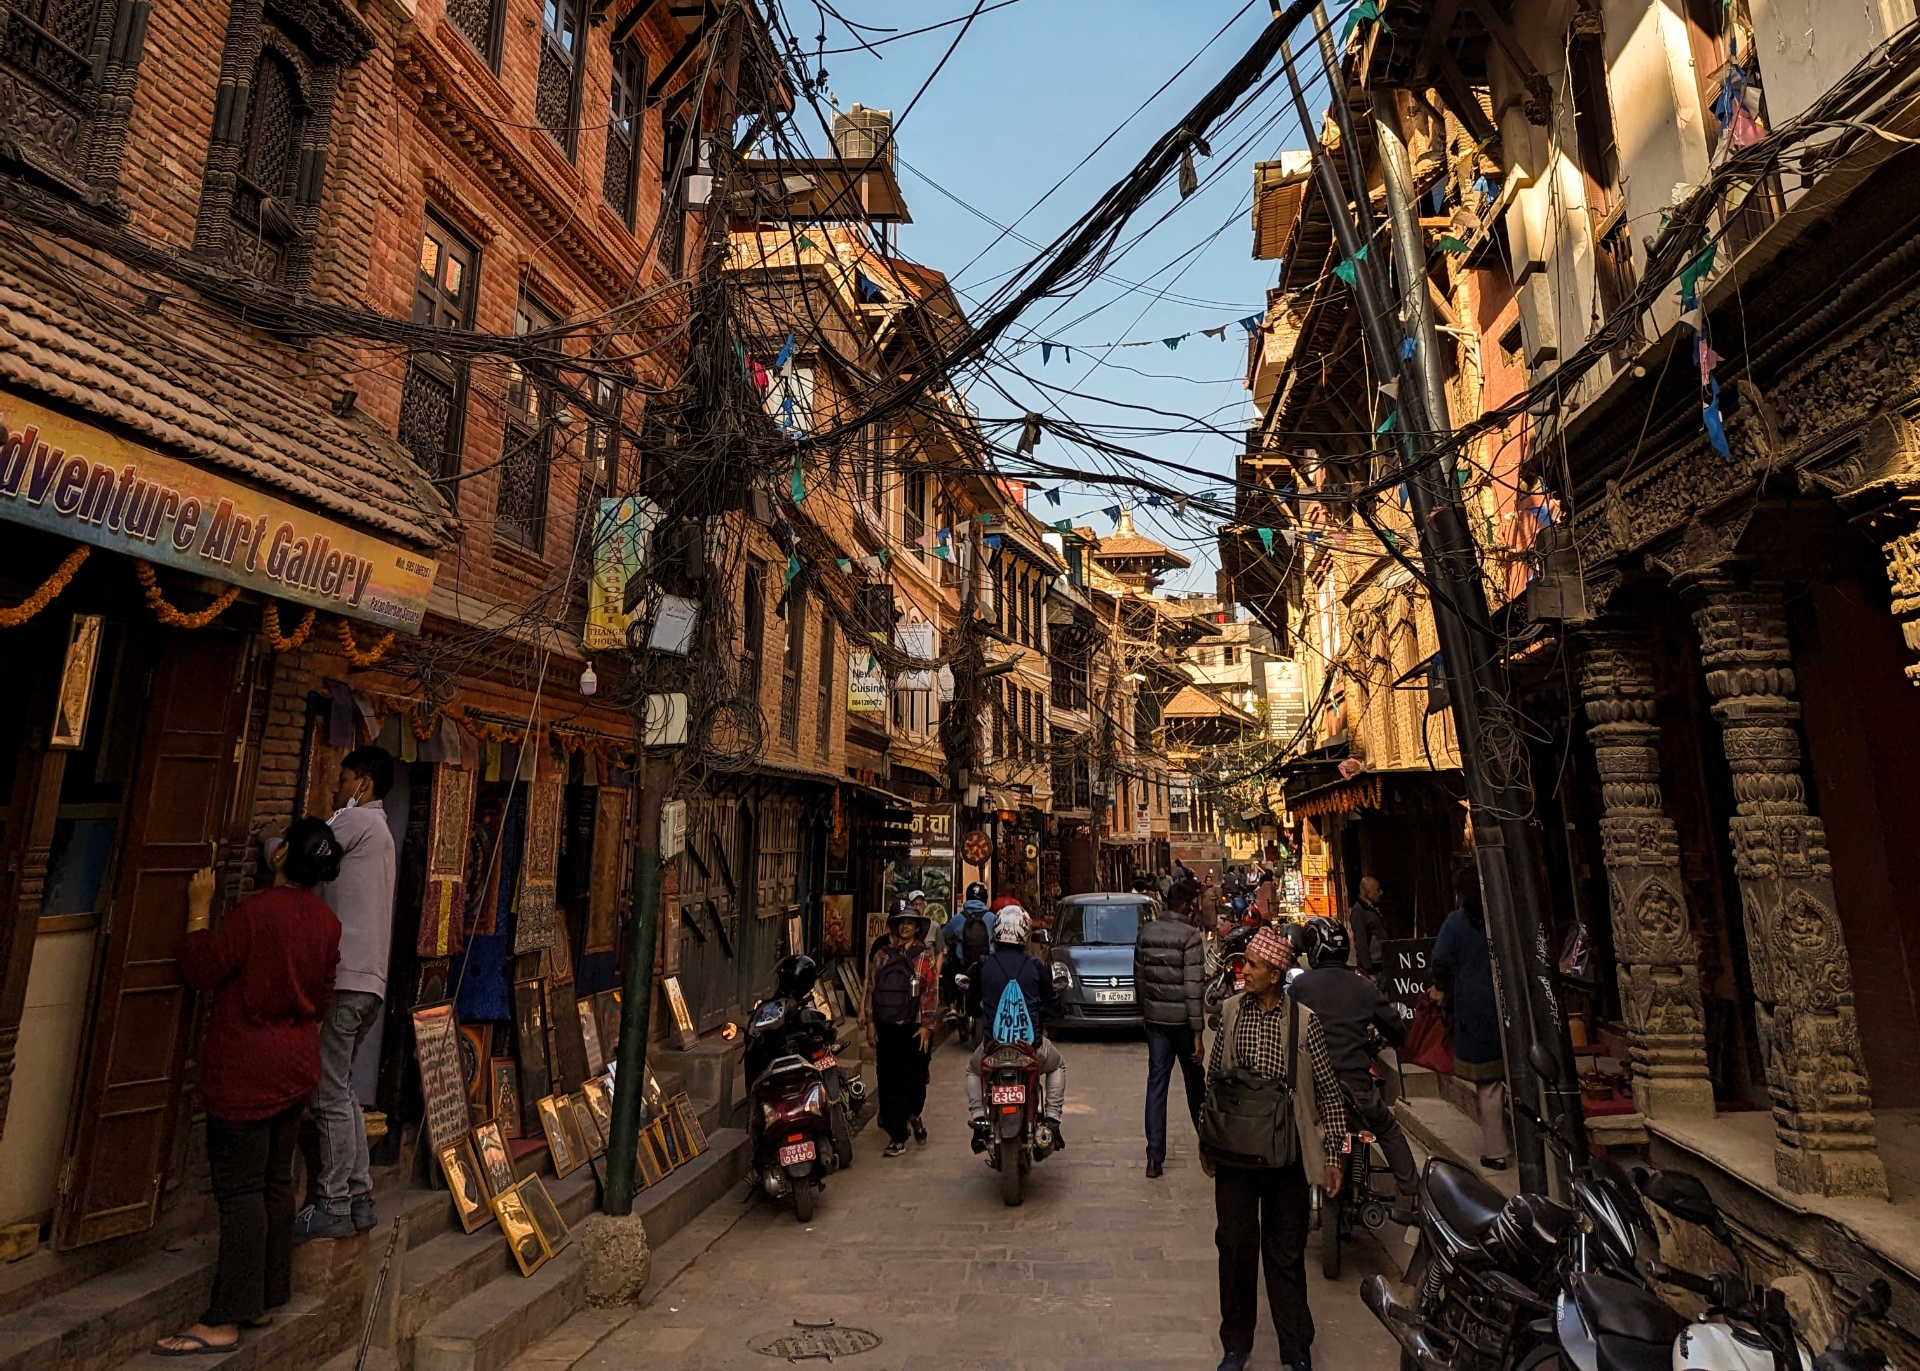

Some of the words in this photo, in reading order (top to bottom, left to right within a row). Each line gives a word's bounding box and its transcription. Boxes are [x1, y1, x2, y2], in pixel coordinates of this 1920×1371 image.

[0, 424, 203, 550] dventure
[200, 497, 268, 572] Art
[266, 521, 374, 607] Gallery
[590, 628, 627, 636] THANGK
[1003, 998, 1024, 1012] LIVE
[999, 1012, 1028, 1028] YOUR
[997, 1027, 1029, 1043] LIFE
